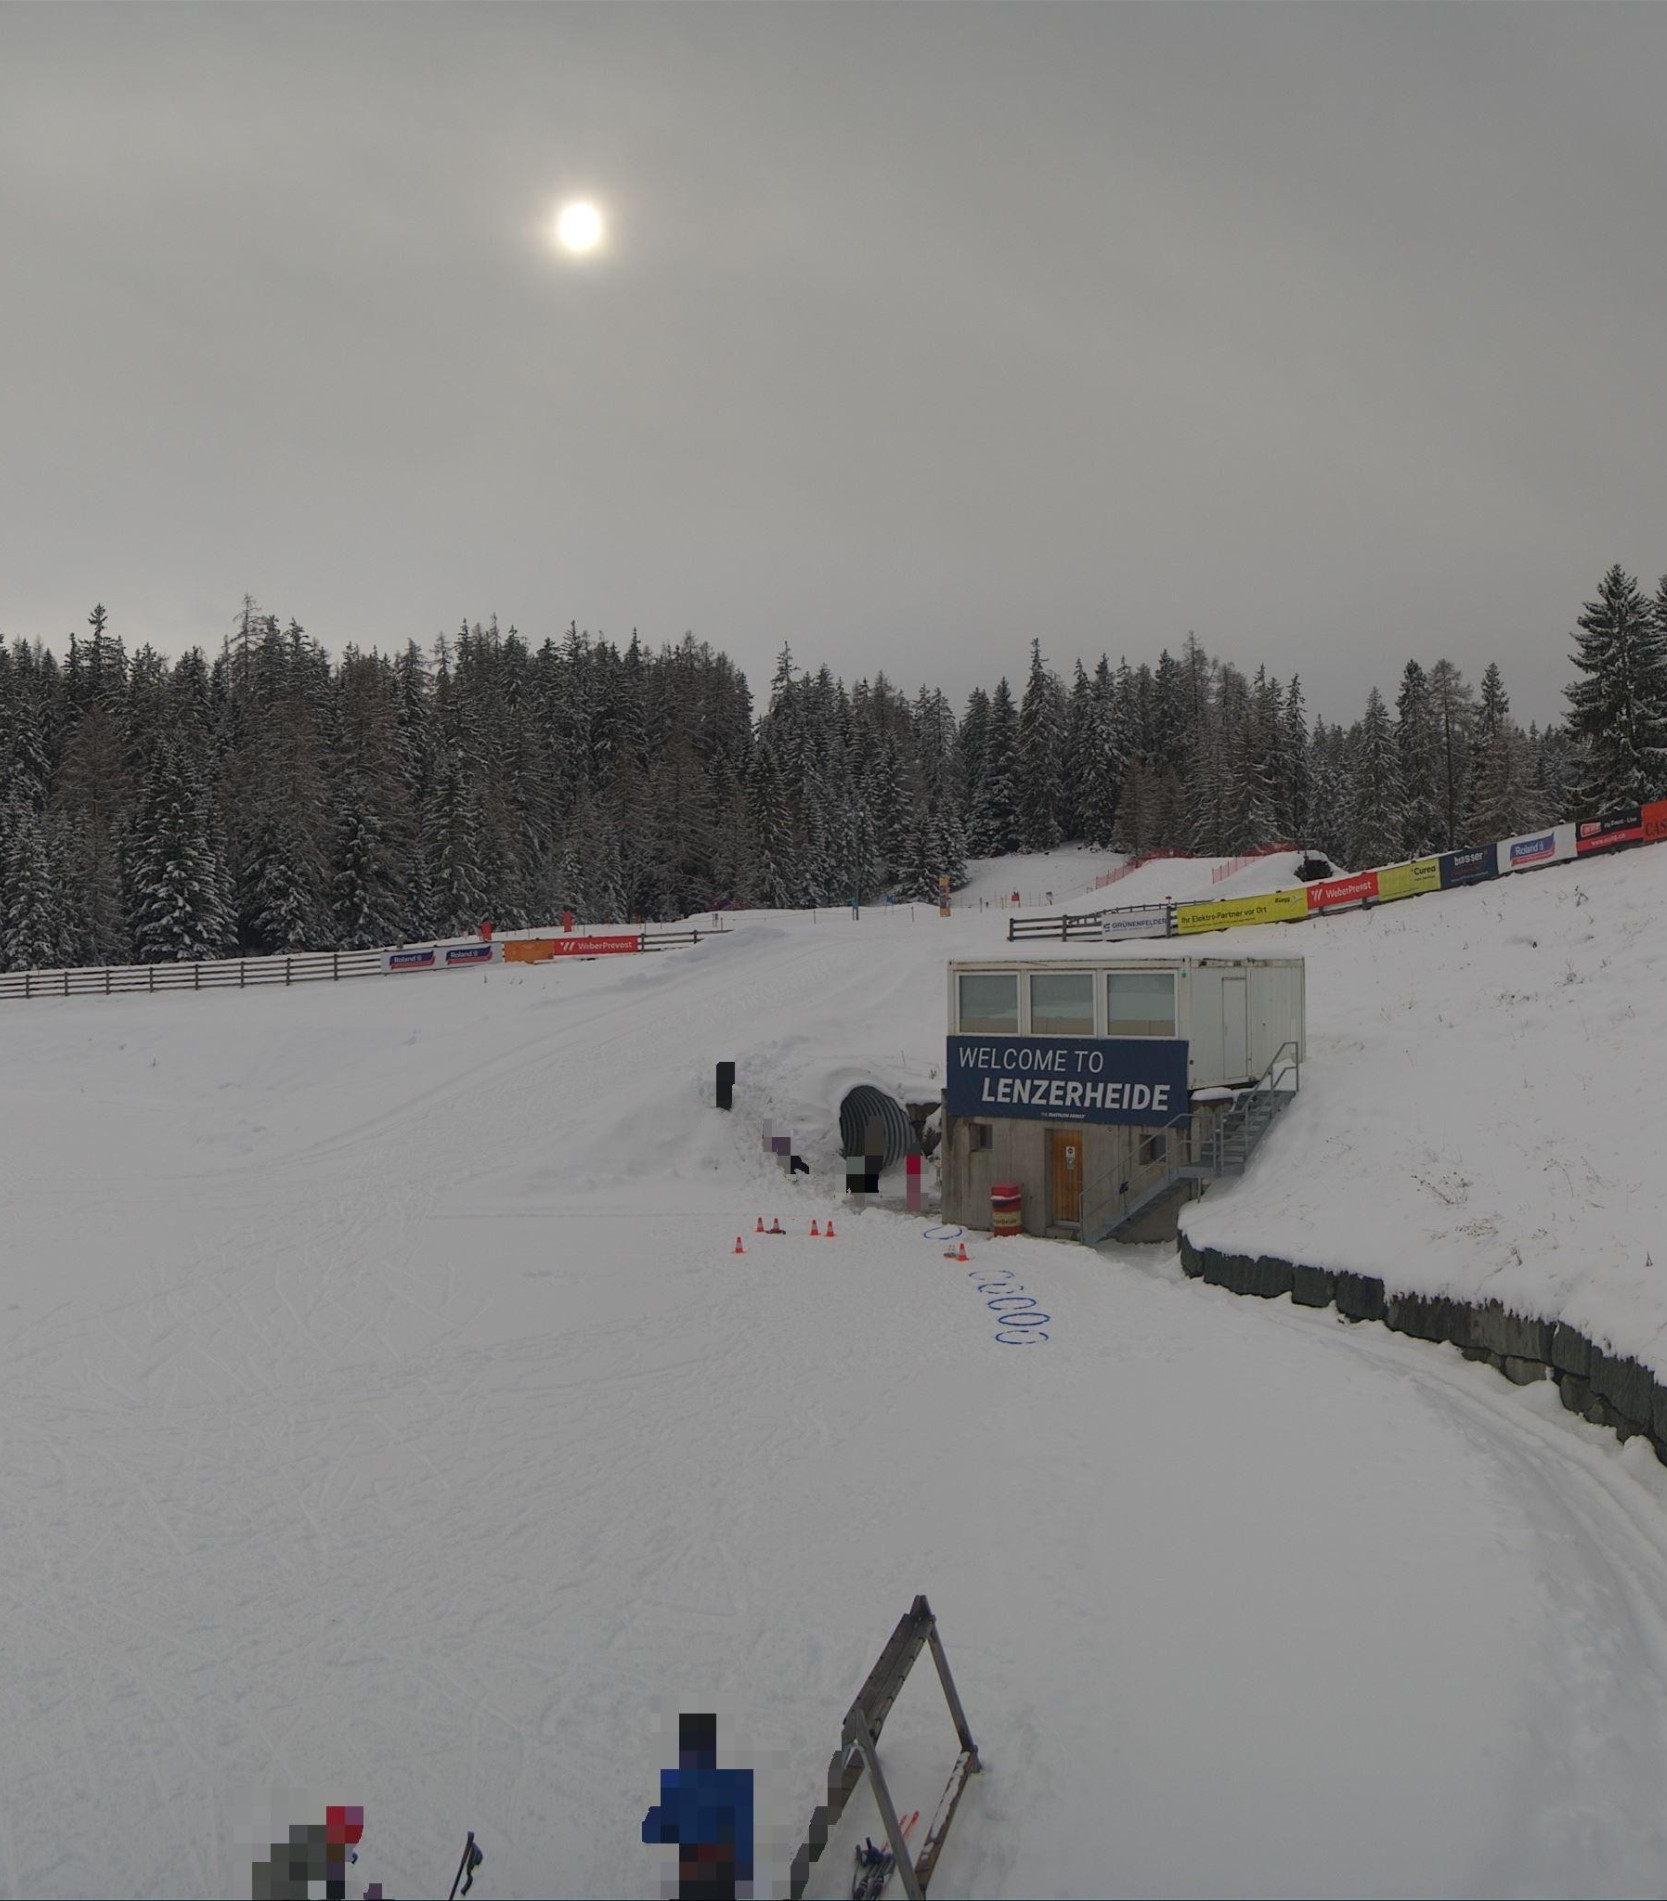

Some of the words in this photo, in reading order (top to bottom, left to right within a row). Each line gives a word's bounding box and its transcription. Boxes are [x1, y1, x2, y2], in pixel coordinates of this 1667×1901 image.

[1515, 842, 1538, 856] Roland
[1181, 916, 1190, 925] Ihr
[1191, 909, 1243, 924] Elektro-Partner
[1244, 909, 1255, 917] vor
[1256, 906, 1267, 914] Ort
[1112, 918, 1167, 929] GRÜNENFELDER
[577, 940, 633, 950] WeberPrevost
[394, 954, 416, 964] Roland
[451, 950, 473, 959] Roland
[959, 1047, 1067, 1072] WELCOME
[1074, 1051, 1104, 1073] TO
[982, 1077, 1171, 1112] LENZERHEIDE
